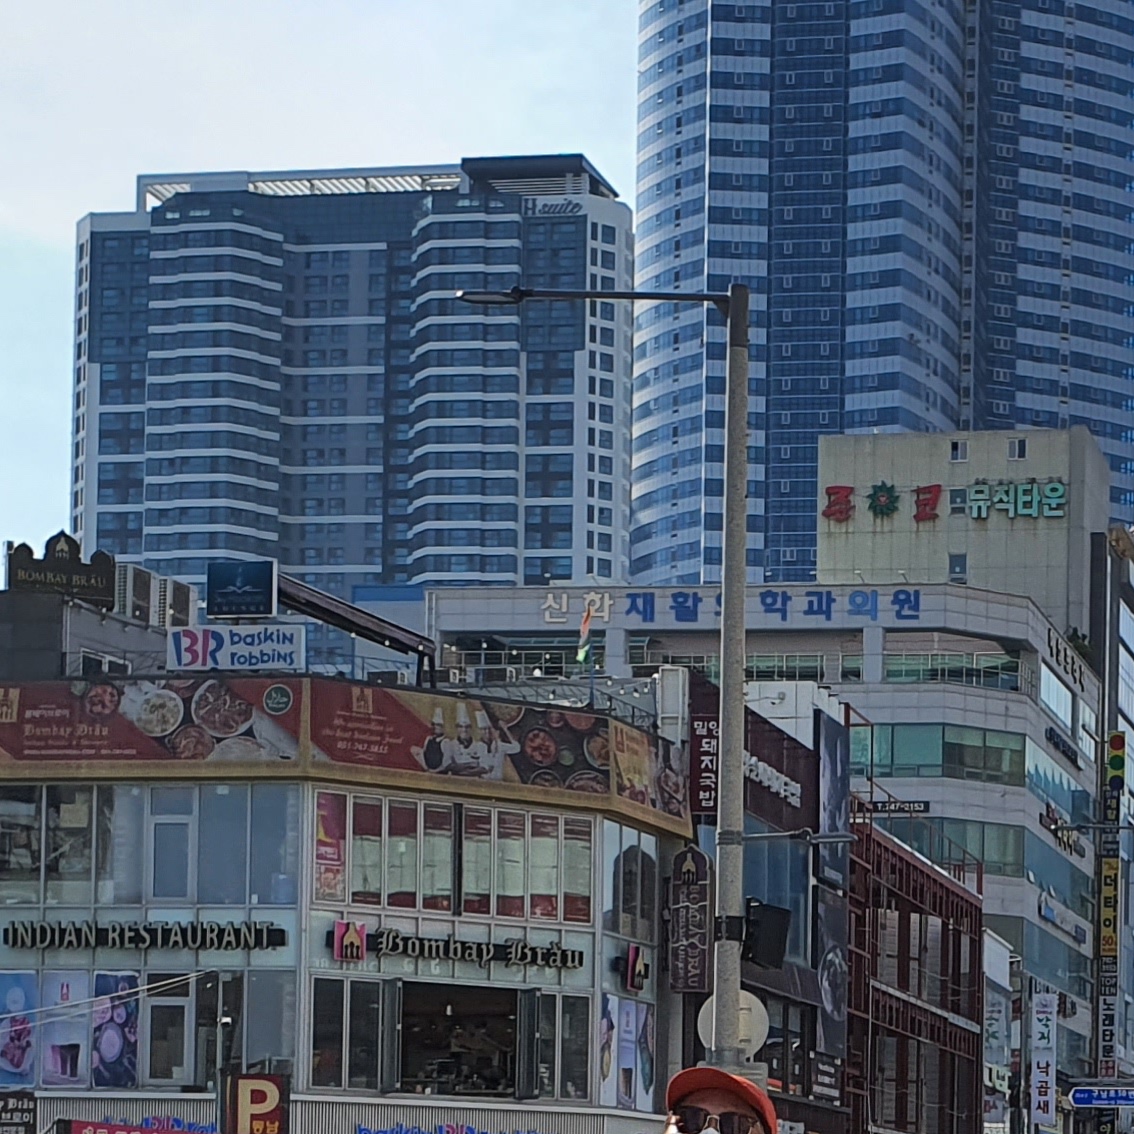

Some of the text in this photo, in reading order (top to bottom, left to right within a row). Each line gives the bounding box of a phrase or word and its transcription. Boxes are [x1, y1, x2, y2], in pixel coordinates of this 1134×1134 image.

[968, 482, 1067, 519] 뮤직타운
[17, 568, 67, 586] BOMBAY
[172, 629, 225, 667] BR
[229, 627, 294, 647] baskin
[229, 647, 295, 666] robbins
[8, 920, 274, 950] INDIAN RESTAURANT
[376, 928, 495, 968] Bombay
